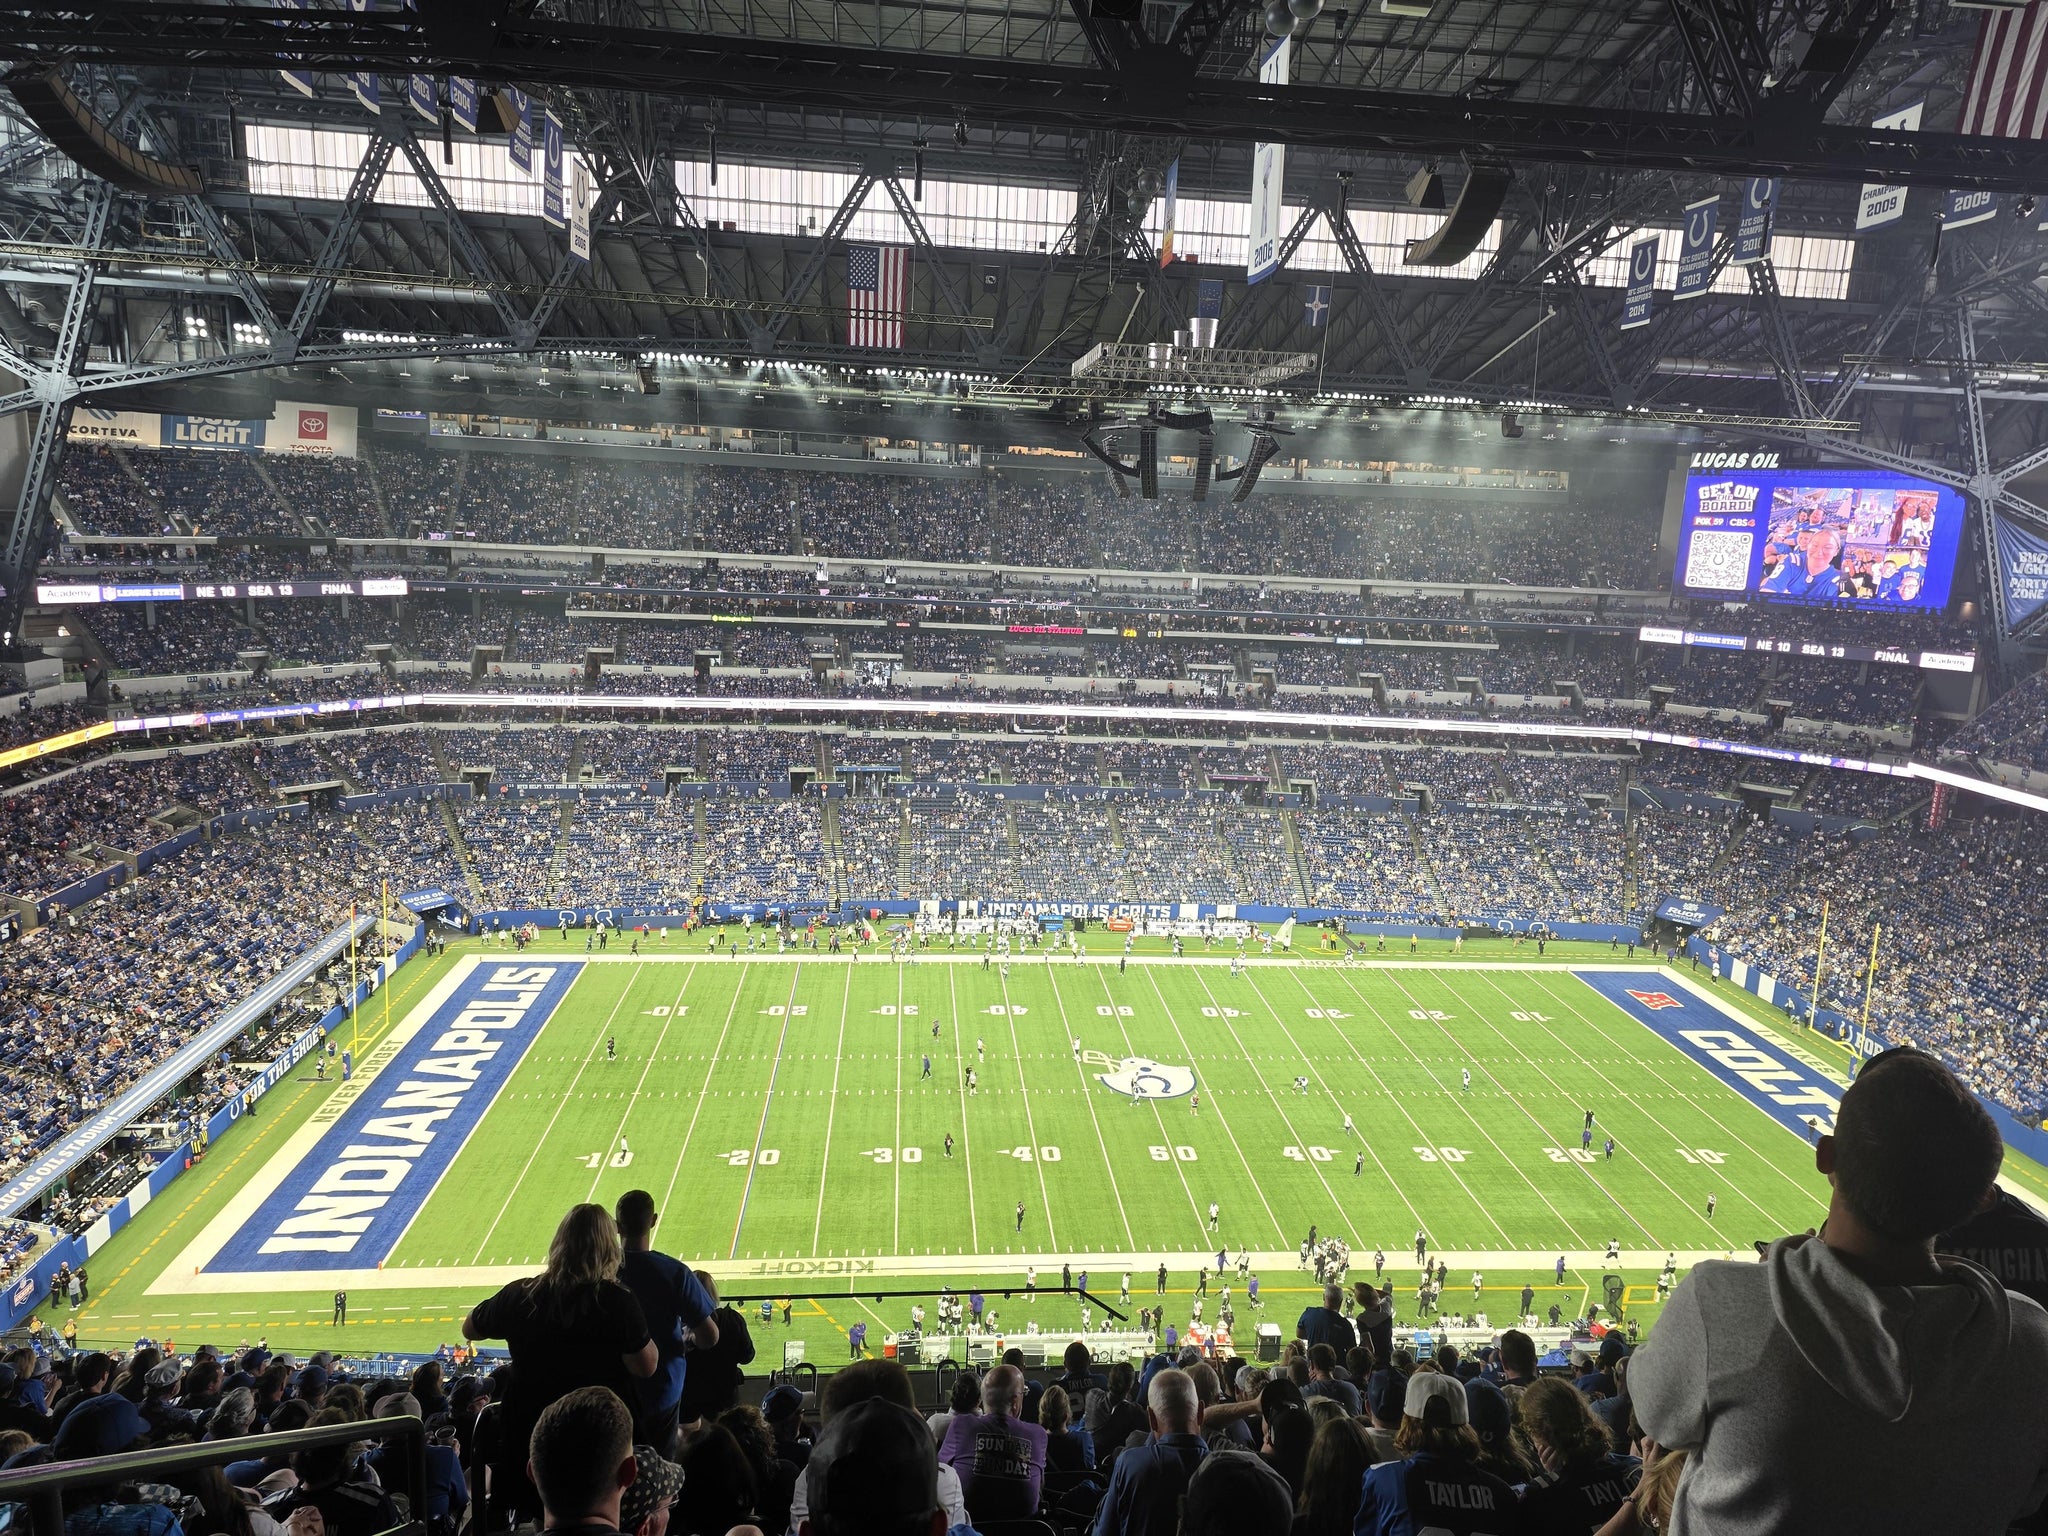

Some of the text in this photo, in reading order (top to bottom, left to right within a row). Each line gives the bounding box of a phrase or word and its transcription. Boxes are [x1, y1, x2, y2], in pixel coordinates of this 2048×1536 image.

[453, 86, 471, 113] 2004
[1866, 196, 1898, 218] 2009
[1954, 192, 1991, 213] 2009
[1741, 218, 1752, 227] AFC
[1254, 239, 1273, 267] 2006
[1680, 250, 1709, 263] AFC SOUTH
[1679, 259, 1709, 273] CHAMPIONS
[1682, 273, 1701, 287] 2013
[1626, 292, 1652, 304] CHAMPIONS
[1629, 305, 1645, 317] 2014
[69, 425, 137, 438] CORTEVA
[176, 424, 251, 444] LIGHT
[290, 444, 333, 455] TOYOTA
[1690, 453, 1781, 468] LUCAS OIL
[1698, 482, 1759, 500] GET ON
[1701, 501, 1752, 511] BOARD!
[2019, 551, 2048, 564] BUD
[2012, 561, 2048, 575] LIGHT
[2009, 577, 2048, 589] PARTY
[46, 589, 92, 599] Academy
[196, 584, 354, 597] NE 10 SEA 13 FINAL
[2011, 588, 2045, 599] ZONE
[1048, 626, 1083, 635] STADIUM
[1756, 640, 1909, 663] NE 10 SEA 13 FINAL
[402, 891, 447, 904] LUCAS OIL
[413, 897, 445, 906] STADIUM
[1119, 904, 1171, 919] COLTS
[652, 1005, 689, 1017] 10
[767, 1005, 808, 1016] 20
[880, 1005, 918, 1016] 30
[989, 1005, 1028, 1016] 40
[1096, 1005, 1134, 1017] 50
[1201, 1006, 1240, 1018] 40
[1305, 1008, 1344, 1020] 30
[1408, 1009, 1448, 1021] 20
[1510, 1011, 1547, 1022] 10
[1756, 1029, 1780, 1039] IT
[1777, 1042, 1837, 1074] TAKES
[243, 1027, 320, 1110] FOR THE SHOE
[310, 1039, 404, 1124] NEVER FORGET
[257, 966, 558, 1255] INDIANAPOLIS
[584, 1151, 634, 1168] 10
[728, 1149, 781, 1166] 20
[874, 1147, 923, 1164] 30
[1011, 1146, 1061, 1162] 40
[1148, 1145, 1199, 1162] 50
[1283, 1146, 1334, 1162] 40
[1412, 1146, 1467, 1162] 30
[1543, 1147, 1597, 1163] 20
[1675, 1148, 1724, 1164] 10
[0, 1113, 118, 1210] LUCAS OIL STADIUM
[752, 1260, 874, 1276] KICKOFF
[1068, 1376, 1094, 1391] TAYLOR
[977, 1437, 1031, 1456] SUNDAY
[1425, 1480, 1495, 1511] TAYLOR
